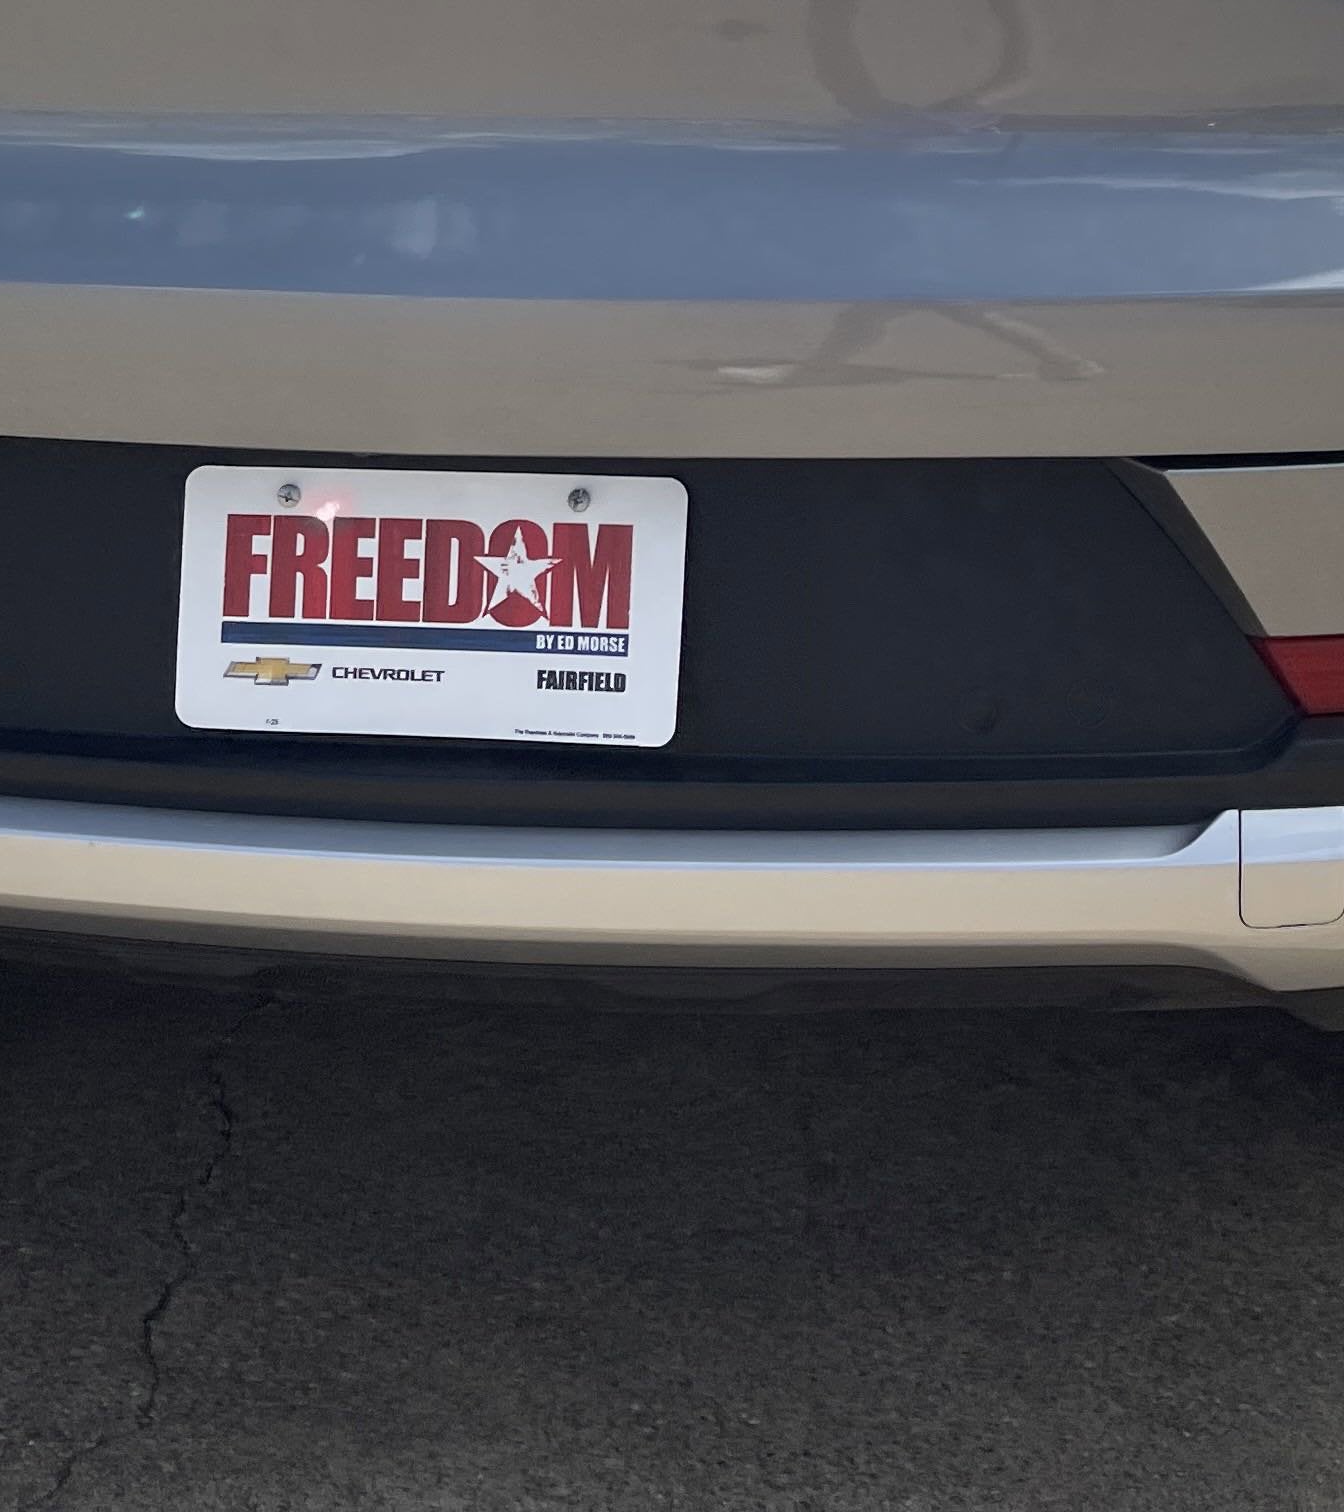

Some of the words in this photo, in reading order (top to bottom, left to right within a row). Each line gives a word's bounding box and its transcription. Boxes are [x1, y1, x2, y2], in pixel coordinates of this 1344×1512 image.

[222, 513, 634, 630] FREEDOM
[535, 634, 554, 650] BY
[556, 635, 574, 651] ED
[577, 636, 626, 653] MORSE
[331, 666, 445, 683] CHEVROLET
[536, 669, 627, 693] FAIRFIELD
